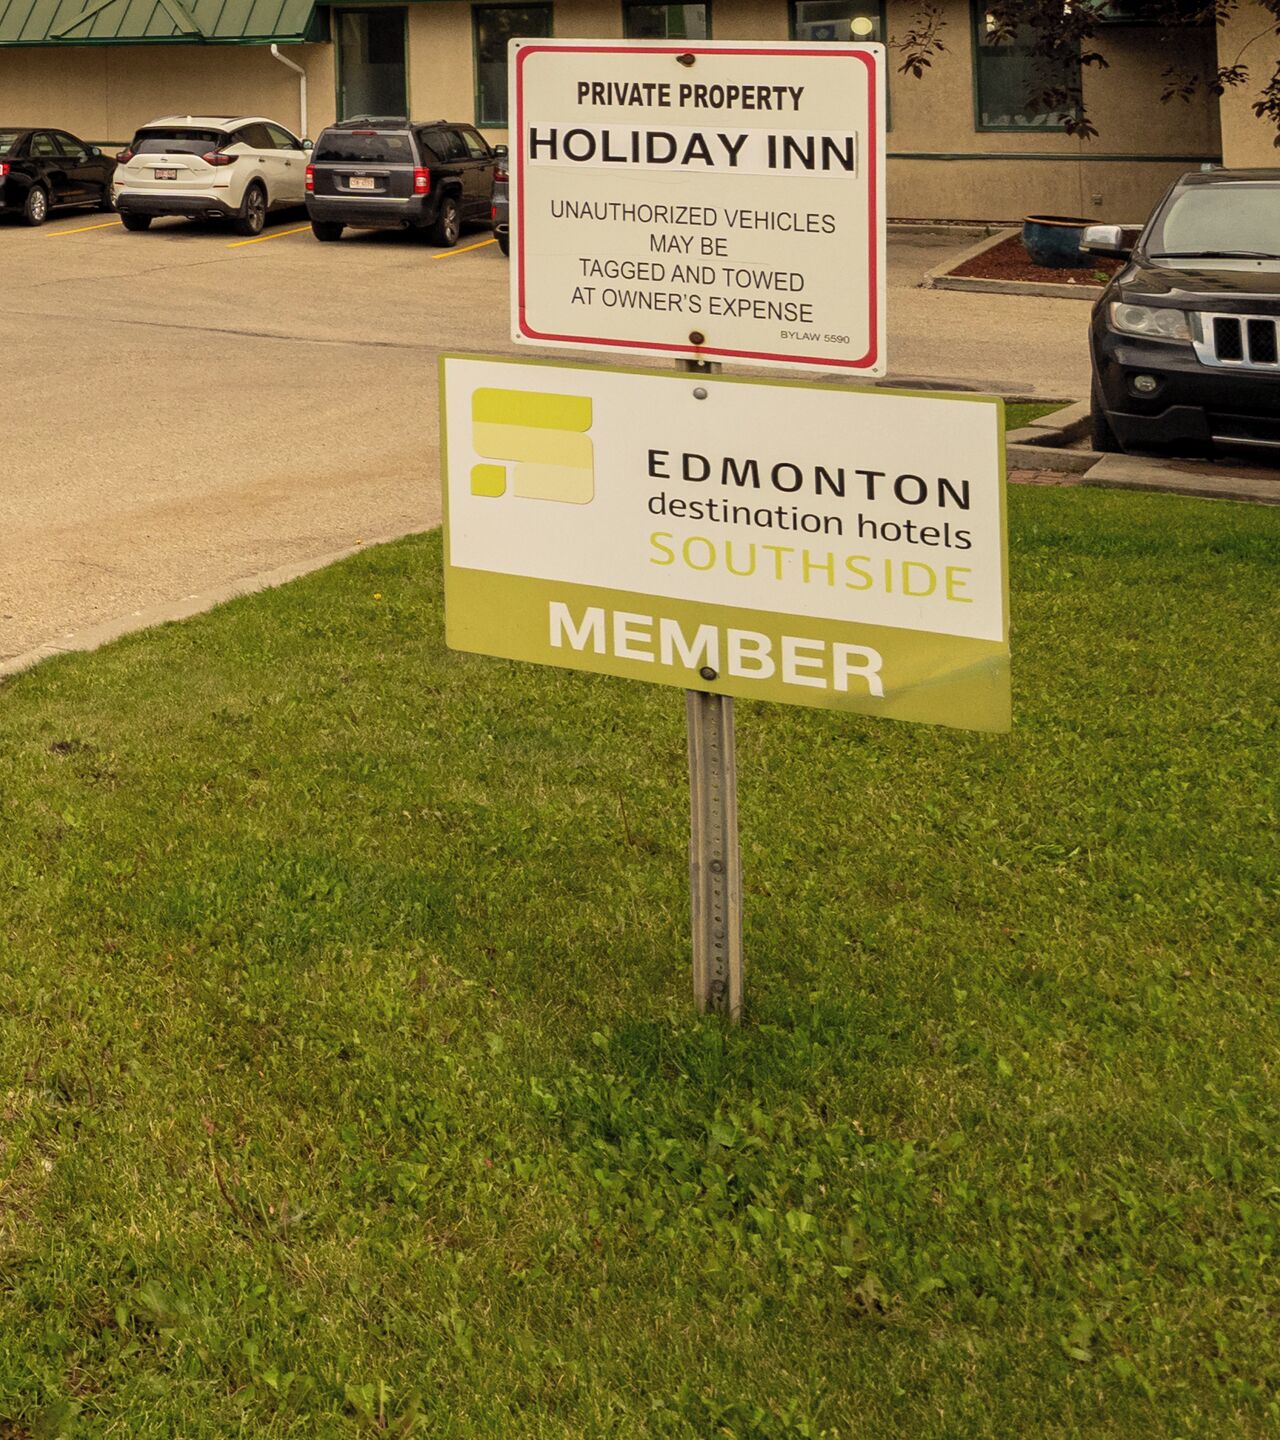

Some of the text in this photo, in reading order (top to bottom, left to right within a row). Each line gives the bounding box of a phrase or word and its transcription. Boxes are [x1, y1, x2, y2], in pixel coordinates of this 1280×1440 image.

[577, 81, 805, 111] PRIVATE PROPERTY
[529, 127, 855, 172] HOLIDAY INN
[551, 199, 836, 234] UNAUTHORIZED VEHICLES
[650, 233, 728, 257] MAY BE
[579, 258, 804, 292] TAGGED AND TOWED
[571, 286, 814, 323] AT OWNER'S EXPENSE
[780, 330, 850, 345] BYLAW 5590
[647, 448, 971, 510] EDMONTON
[647, 491, 972, 550] destination hotels
[650, 531, 973, 603] SOUTHSIDE
[548, 601, 885, 698] MEMBER
